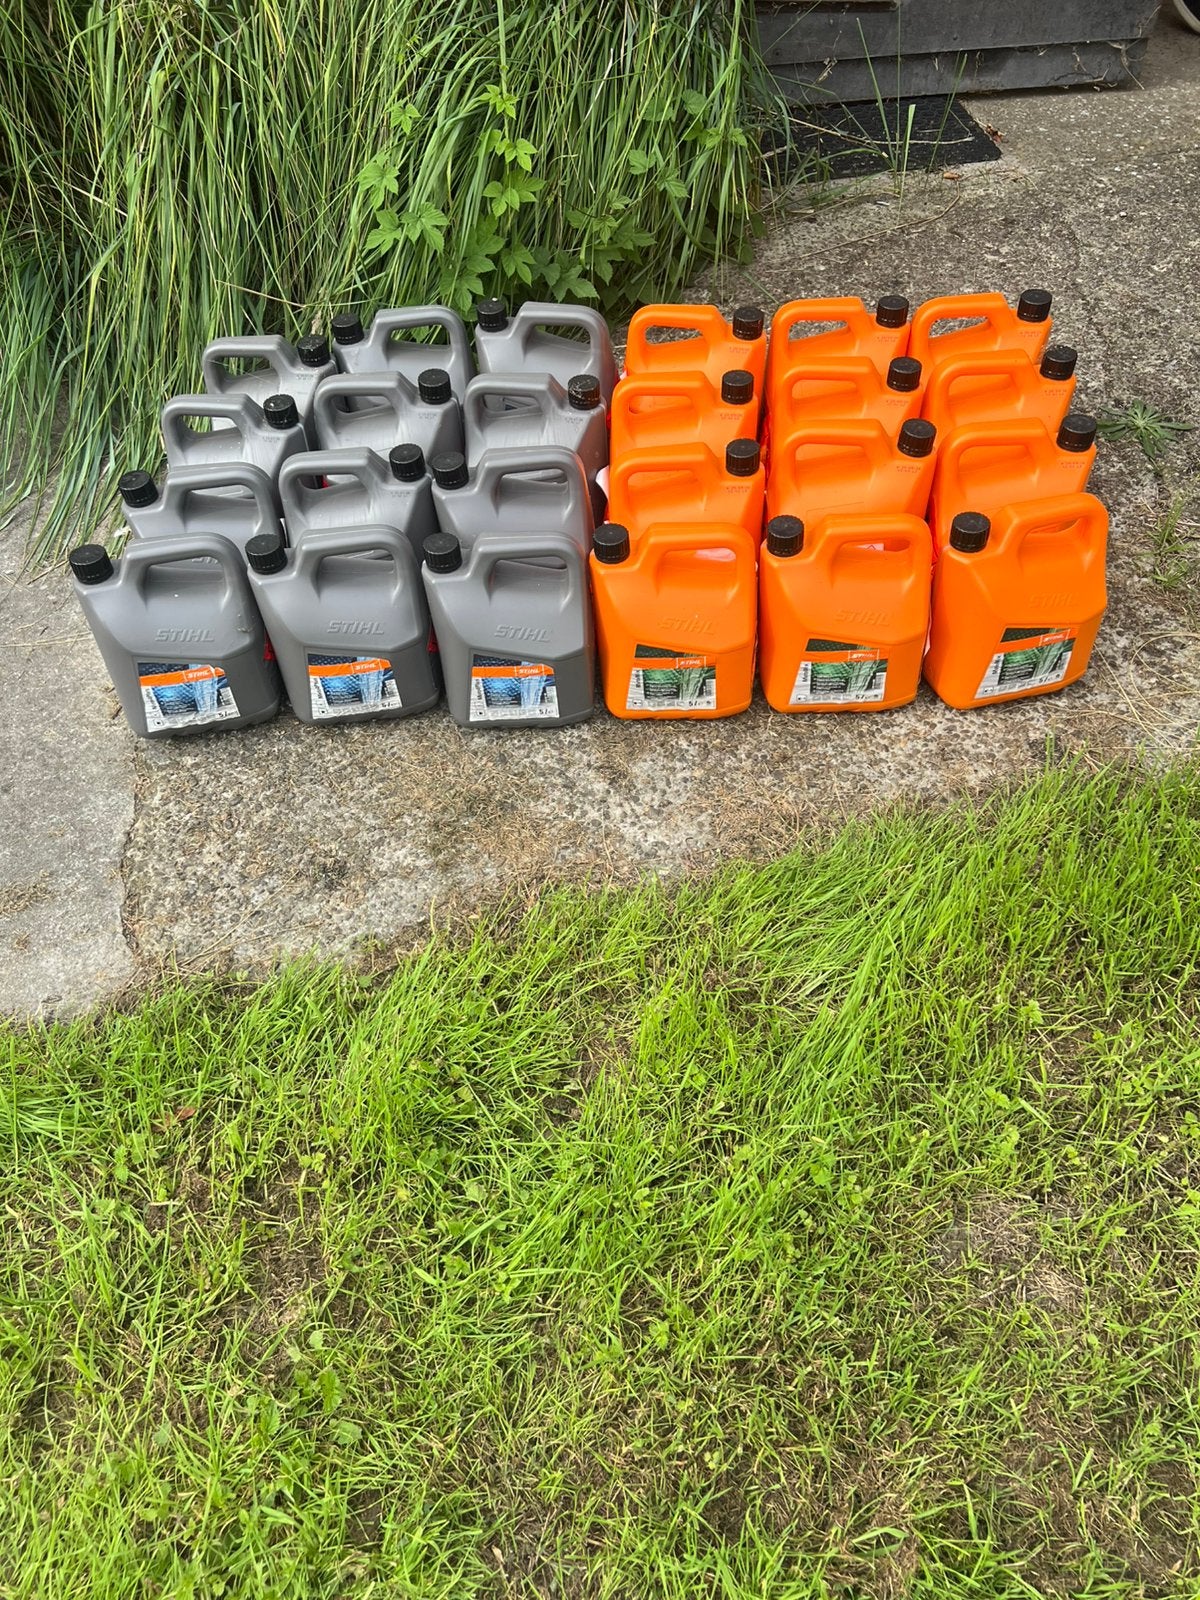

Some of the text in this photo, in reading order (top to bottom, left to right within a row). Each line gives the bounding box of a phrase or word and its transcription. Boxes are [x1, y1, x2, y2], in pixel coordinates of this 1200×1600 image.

[658, 616, 714, 636] STIHL
[834, 608, 890, 627] STIHL
[155, 628, 215, 642] STIHL
[327, 620, 385, 636] STIHL
[493, 624, 551, 643] STIHL
[187, 670, 209, 678] STIHL
